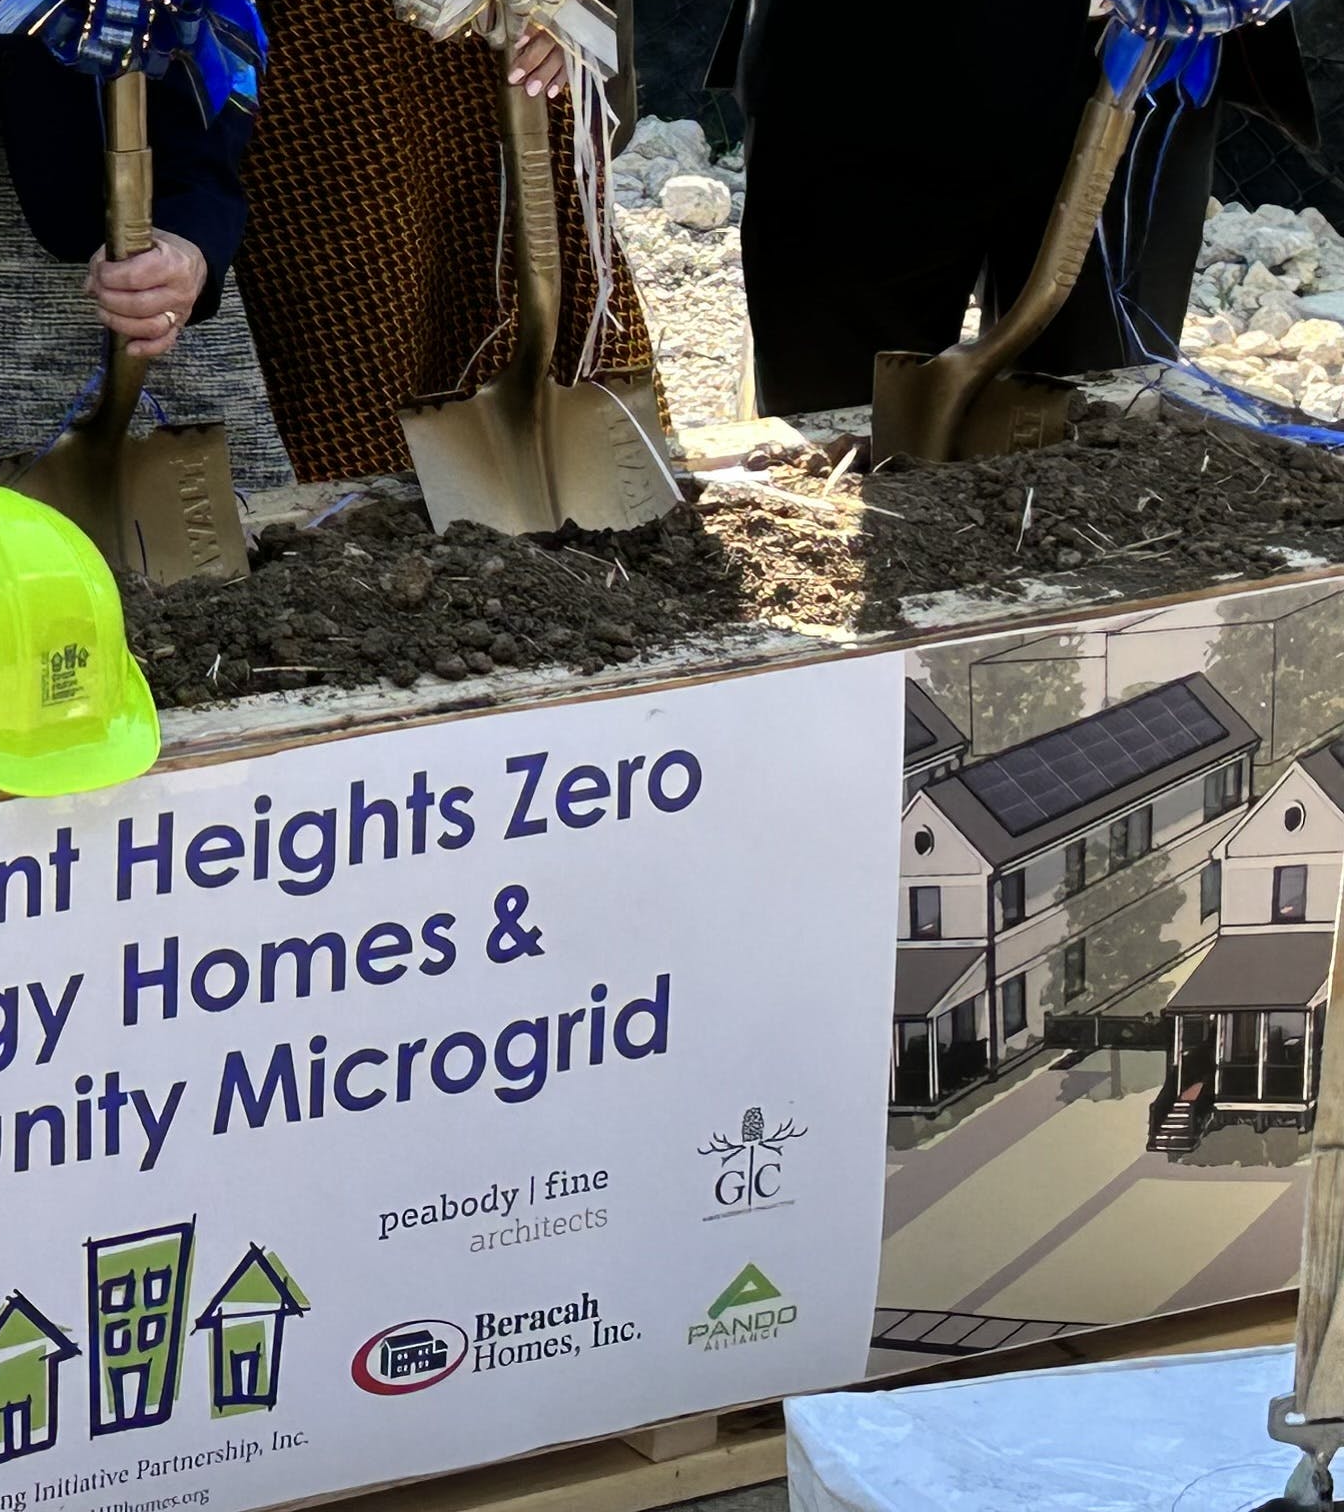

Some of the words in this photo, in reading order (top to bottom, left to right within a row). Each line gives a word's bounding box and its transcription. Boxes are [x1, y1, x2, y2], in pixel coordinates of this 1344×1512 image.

[117, 771, 475, 902] Heights
[504, 750, 702, 840] Zero
[123, 913, 456, 1027] Homes
[486, 885, 545, 964] &
[213, 973, 670, 1135] Microgrid
[379, 1184, 519, 1240] peabody
[545, 1171, 608, 1200] fine
[470, 1208, 607, 1252] architects
[472, 1335, 580, 1373] Homes,
[590, 1319, 641, 1348] Inc.
[473, 1292, 599, 1343] Beracah
[688, 1306, 797, 1345] PANDO
[35, 1469, 128, 1502] Initiative
[136, 1440, 262, 1479] Partnership,
[272, 1431, 308, 1450] Inc.
